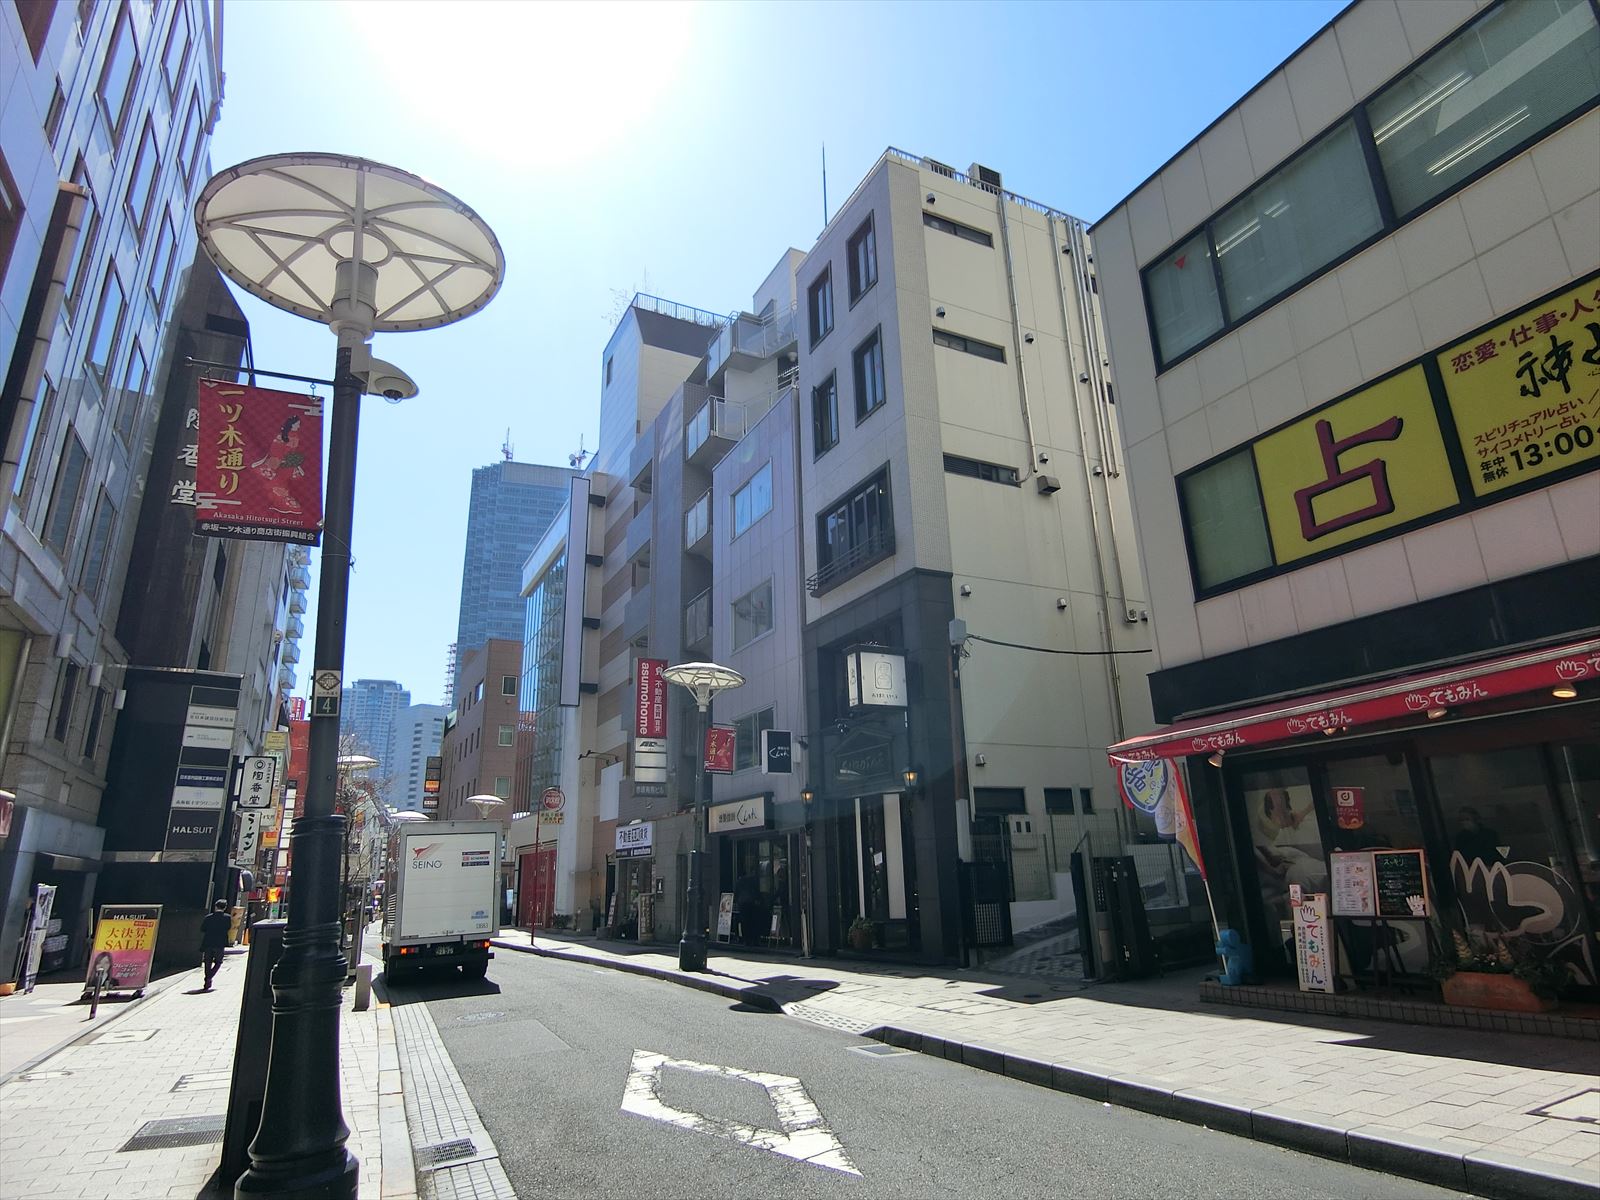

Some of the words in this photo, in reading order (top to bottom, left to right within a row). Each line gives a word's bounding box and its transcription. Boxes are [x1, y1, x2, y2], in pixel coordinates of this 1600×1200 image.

[216, 389, 246, 495] 一ツ木通り
[1480, 456, 1505, 472] 年中
[1294, 416, 1404, 541] 占
[1483, 467, 1509, 483] 無休
[213, 512, 244, 520] Akasaka
[246, 514, 280, 524] Hitotsugi
[281, 518, 304, 526] Street
[202, 522, 315, 541] 赤坂一ツ木通り商店街振興組合
[639, 662, 651, 735] asumohome
[1429, 682, 1489, 705] てもみん
[322, 698, 331, 713] 4
[1306, 711, 1353, 730] てもみん
[1207, 732, 1246, 748] てもみん
[248, 770, 264, 806] 陶香堂
[172, 826, 214, 834] HALSUIT
[242, 813, 256, 852] ラーメン
[412, 860, 443, 870] SEINO
[107, 927, 148, 939] 大決算
[104, 940, 146, 951] SALE
[1306, 924, 1323, 985] てもみん
